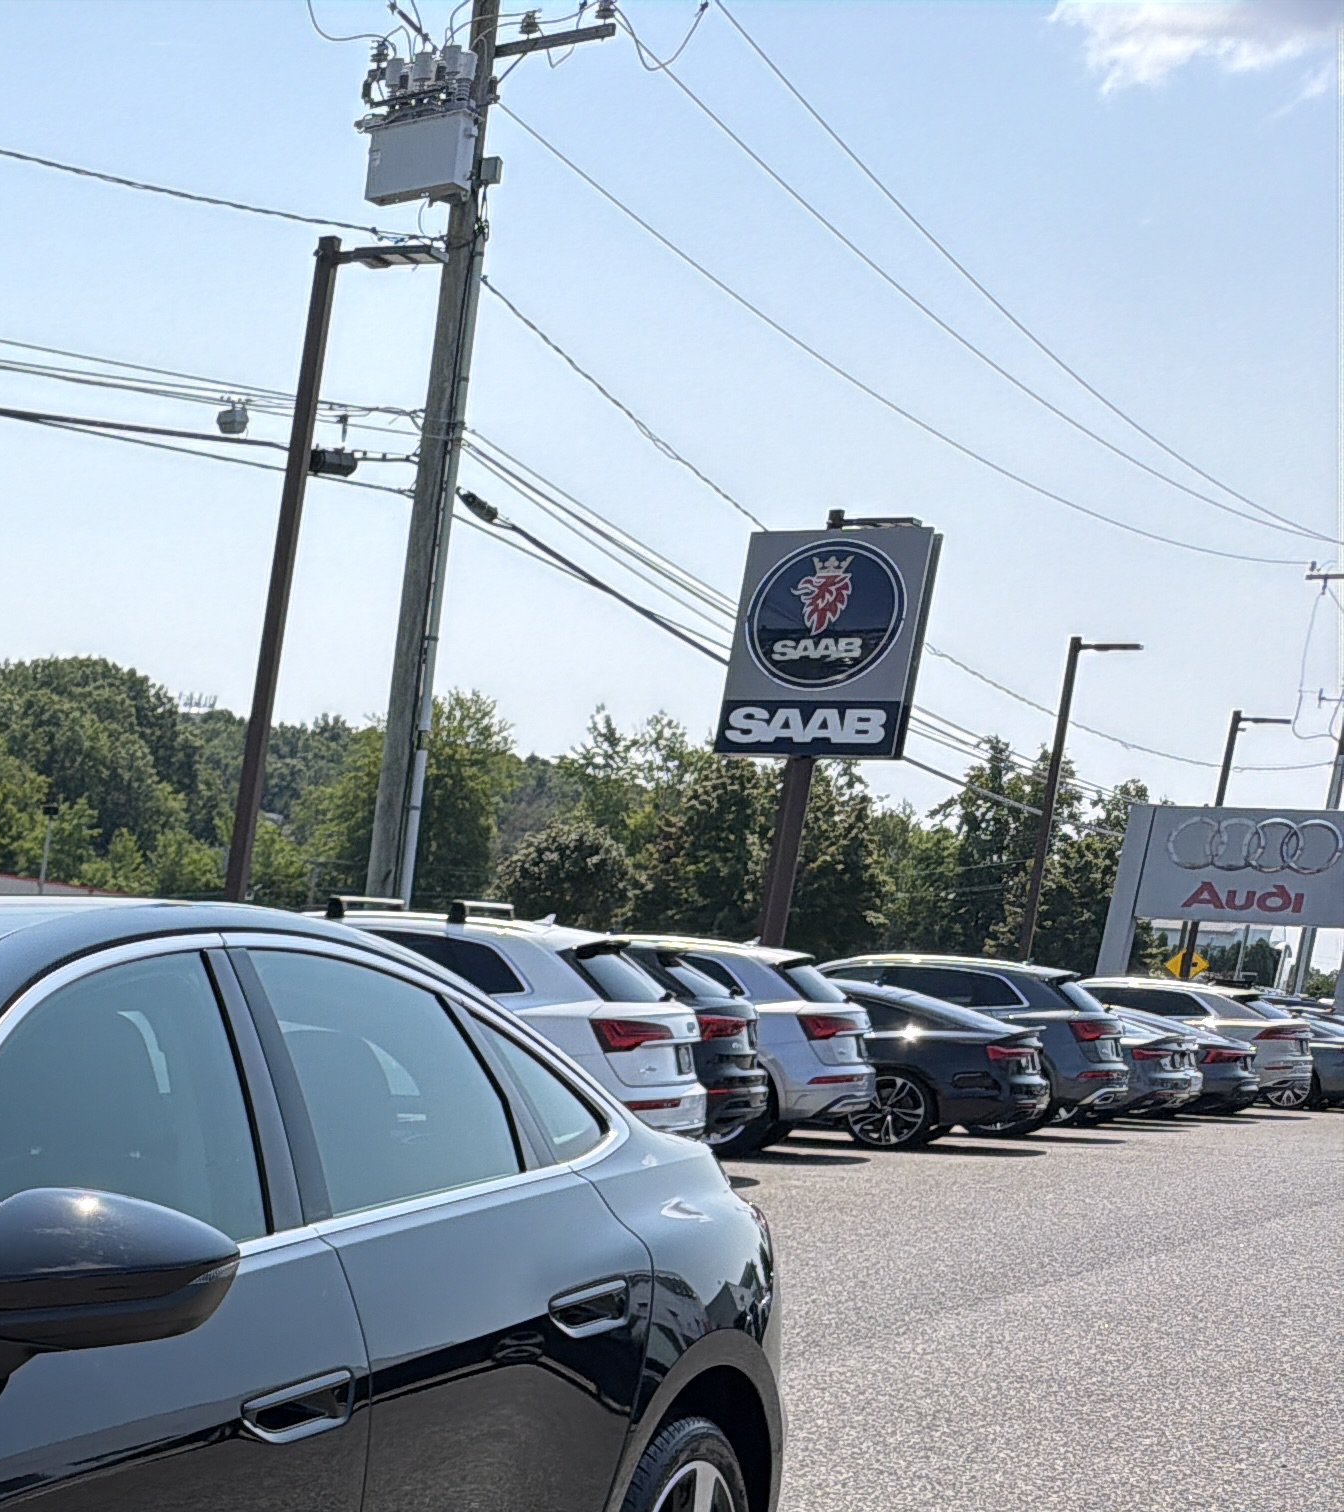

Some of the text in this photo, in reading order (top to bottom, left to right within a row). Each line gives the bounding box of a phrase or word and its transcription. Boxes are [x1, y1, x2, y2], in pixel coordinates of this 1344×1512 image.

[772, 637, 862, 662] SAAB
[724, 706, 888, 745] SAAB
[1180, 880, 1305, 914] Audi
